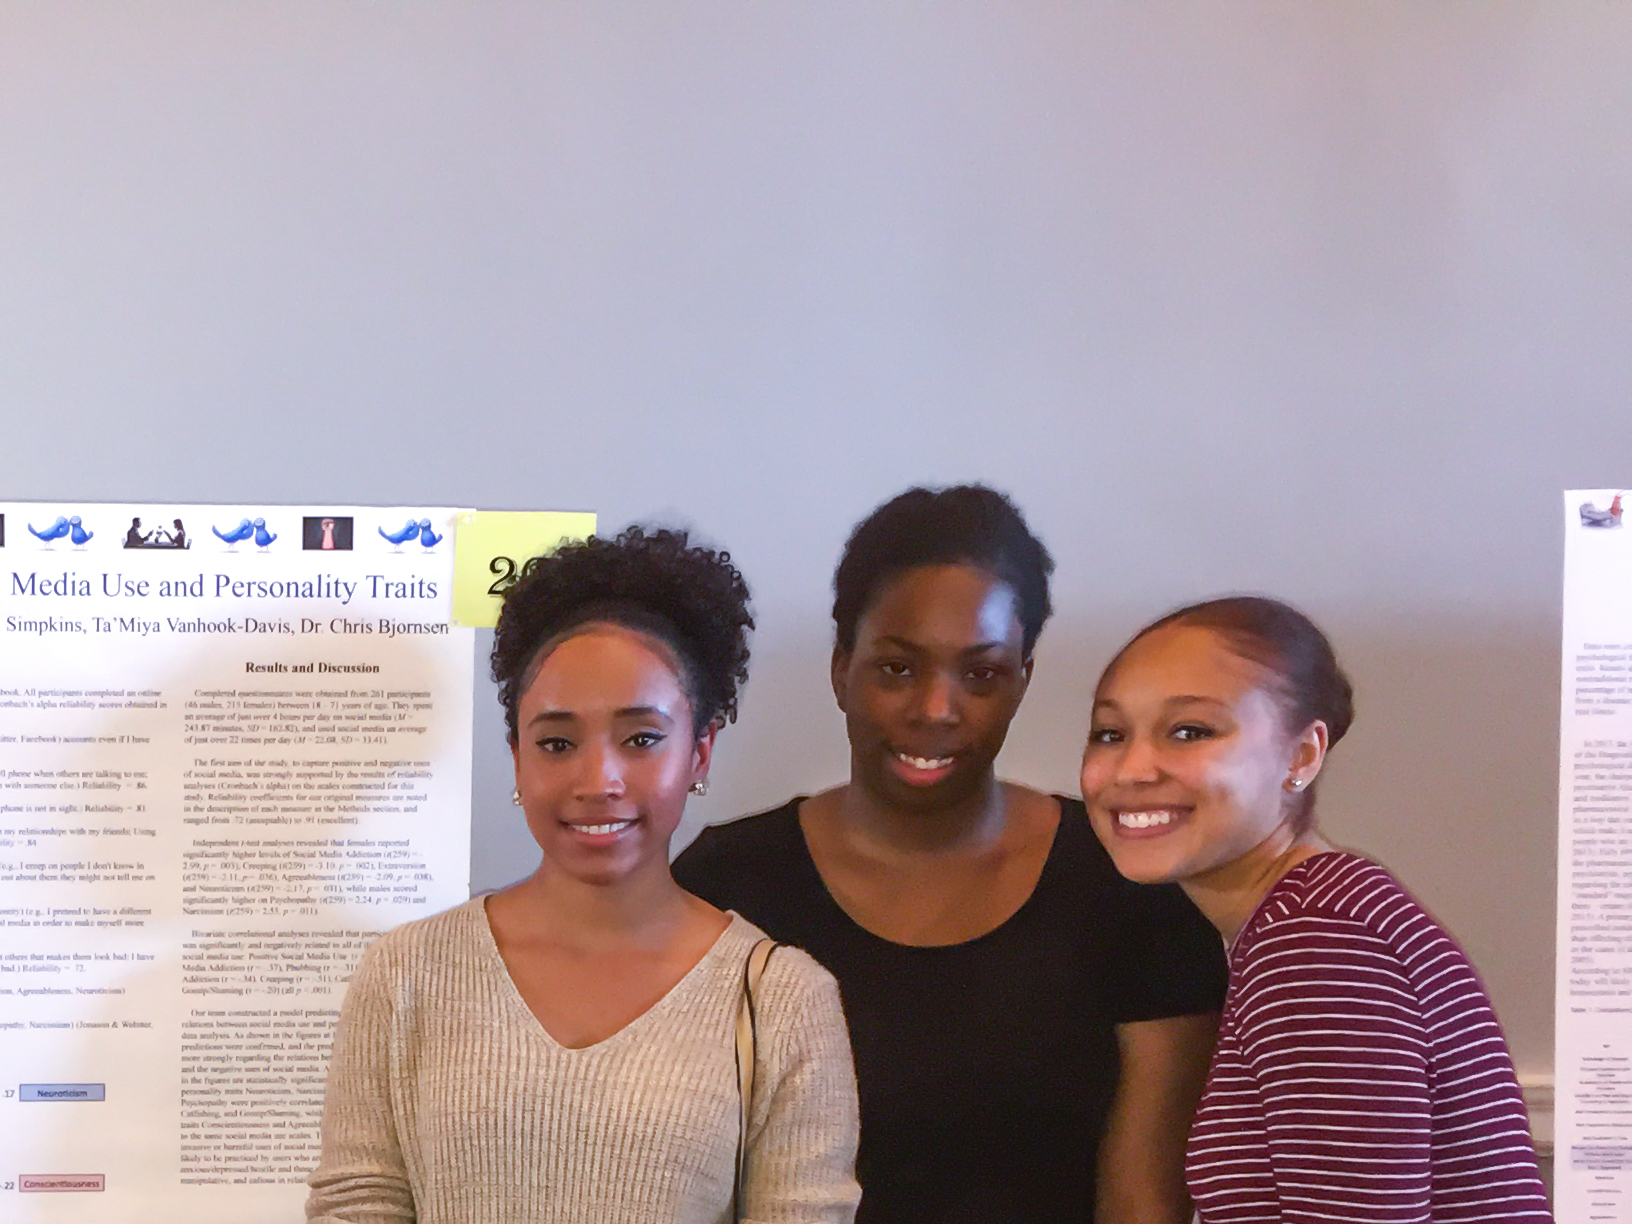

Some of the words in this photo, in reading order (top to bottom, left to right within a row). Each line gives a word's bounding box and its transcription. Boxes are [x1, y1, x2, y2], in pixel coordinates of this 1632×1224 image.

[11, 571, 91, 596] Media
[102, 573, 149, 597] Use
[159, 572, 203, 597] and
[215, 572, 357, 605] Personality
[365, 573, 437, 599] Traits
[6, 615, 86, 636] Simpkins,
[166, 616, 295, 636] Vanhook-Davis,
[329, 617, 373, 634] Chris
[378, 617, 449, 639] Bjornsen
[245, 661, 288, 673] Results
[291, 662, 313, 673] and
[318, 661, 379, 673] Discussion
